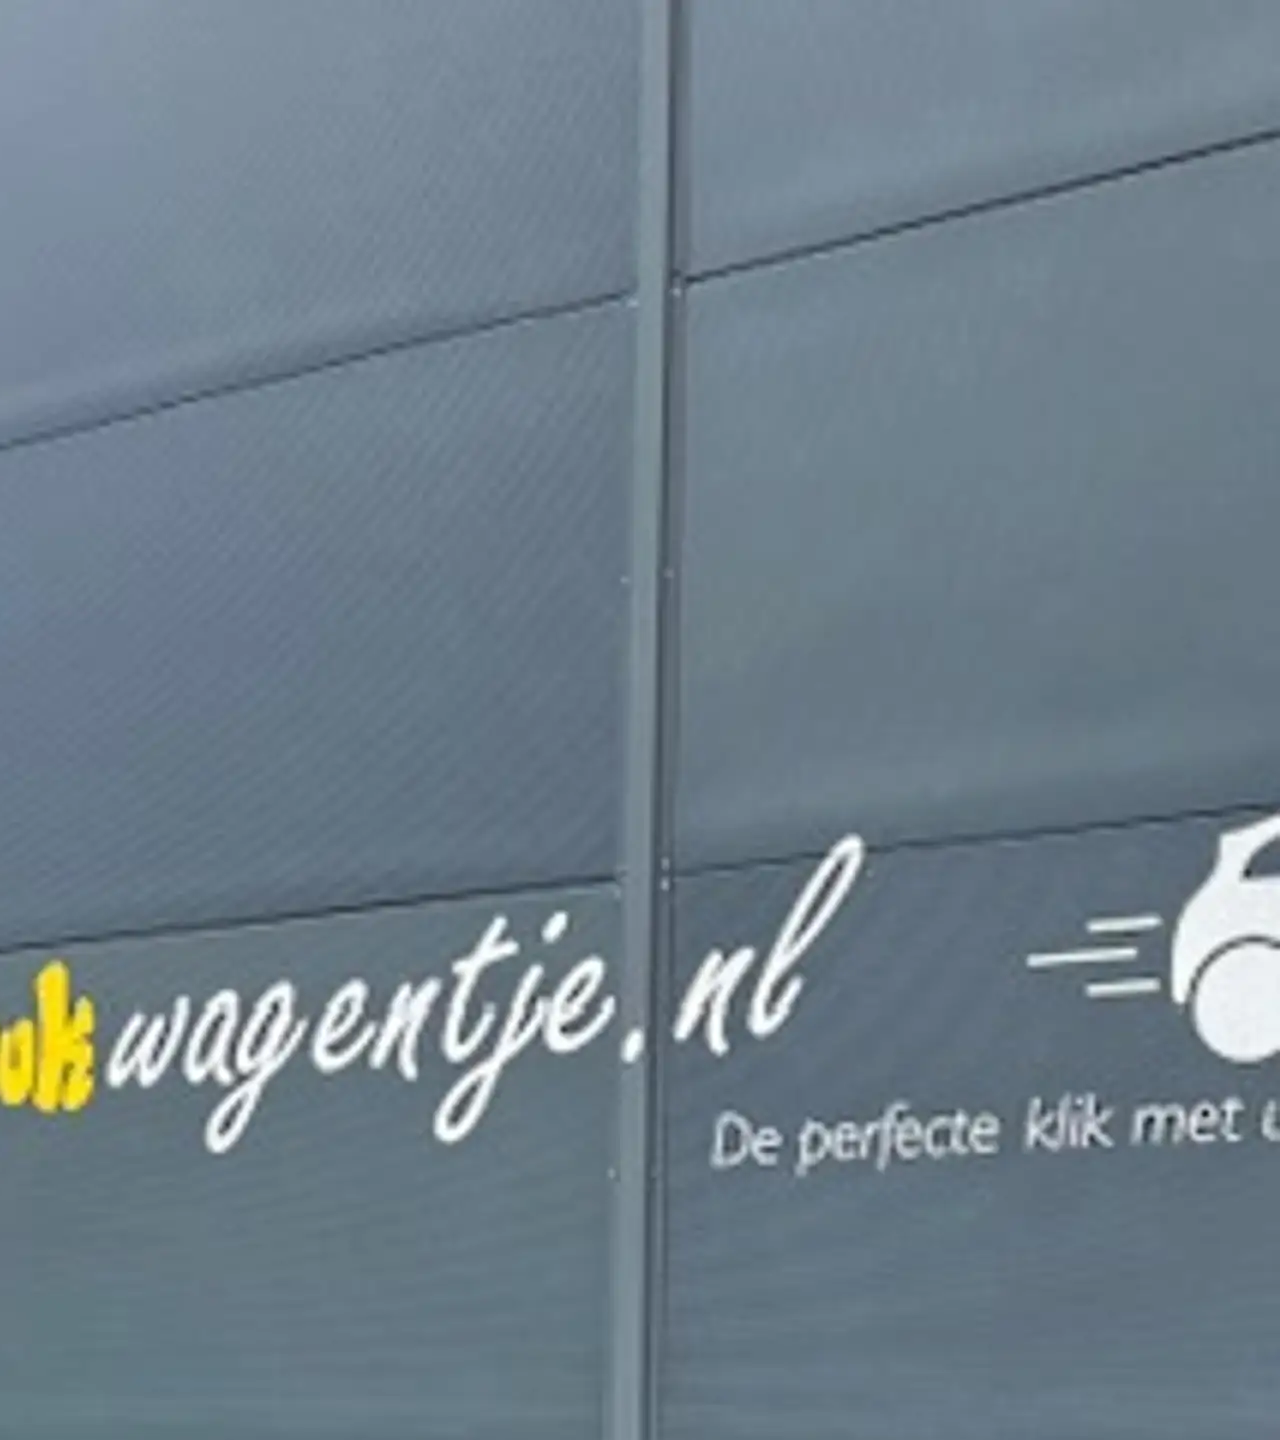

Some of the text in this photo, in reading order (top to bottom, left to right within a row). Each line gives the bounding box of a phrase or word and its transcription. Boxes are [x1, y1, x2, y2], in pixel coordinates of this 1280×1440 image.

[710, 1110, 783, 1169] De
[795, 1101, 1000, 1177] perfecte
[1024, 1091, 1115, 1151] klik
[1129, 1096, 1244, 1146] met
